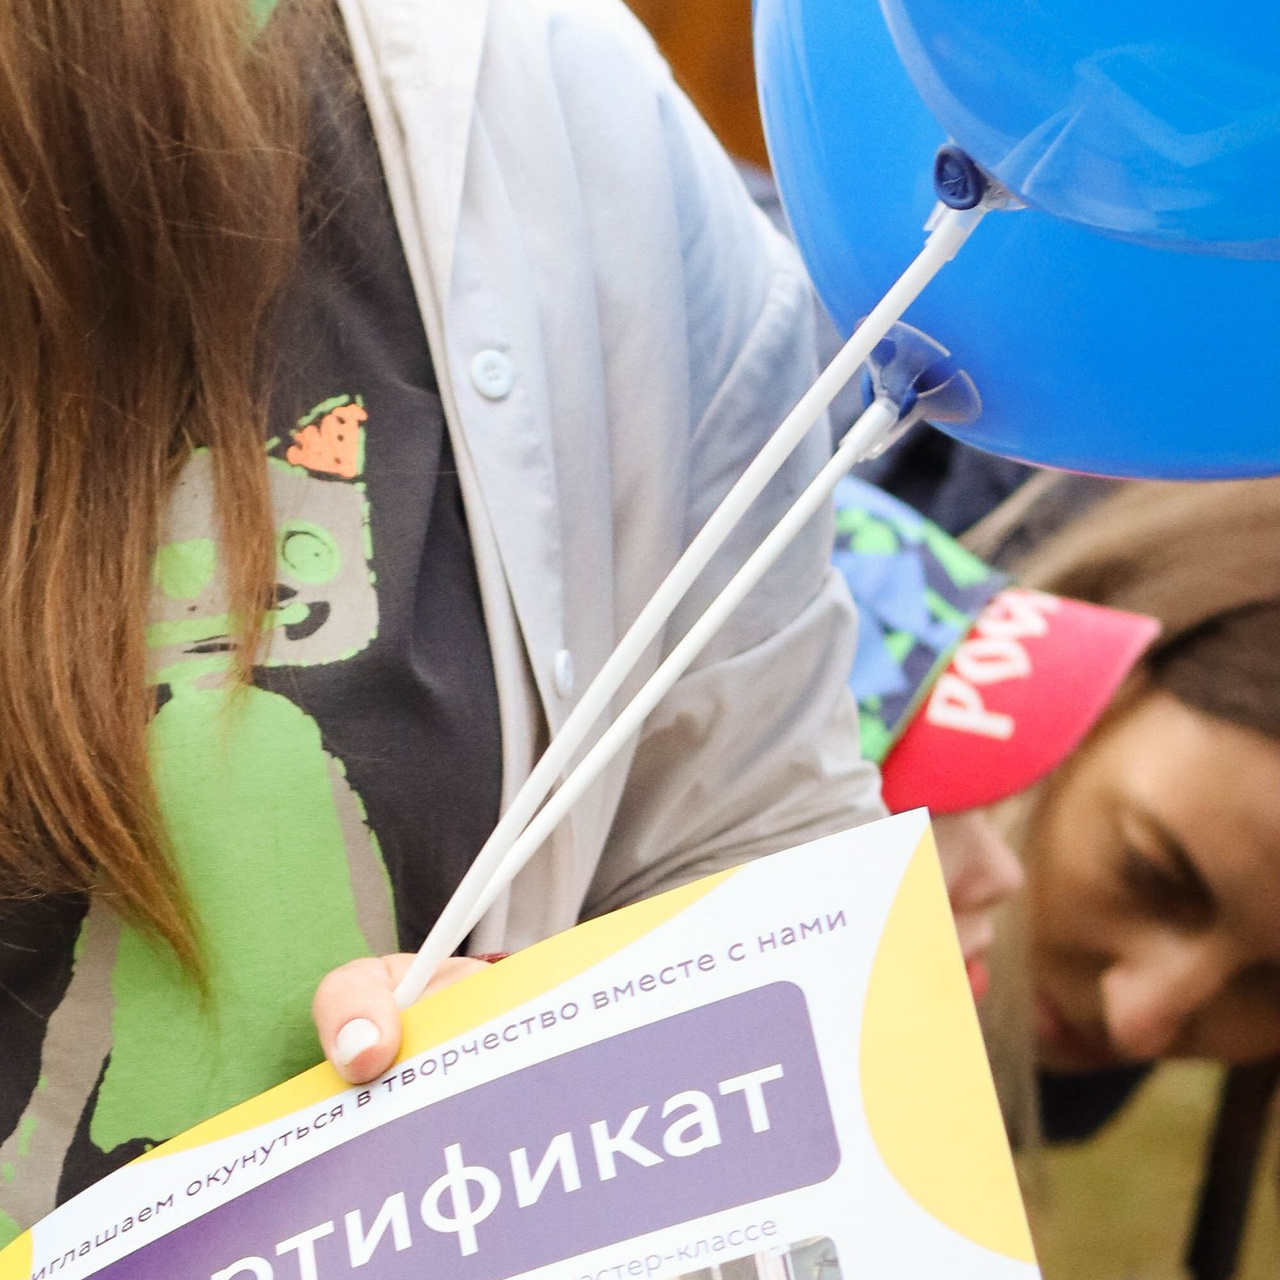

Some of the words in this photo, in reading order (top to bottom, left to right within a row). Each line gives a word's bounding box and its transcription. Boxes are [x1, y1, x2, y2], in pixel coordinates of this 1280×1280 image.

[186, 1103, 345, 1199] окунуться
[357, 1088, 373, 1110] в
[383, 1001, 578, 1094] творчество
[593, 952, 717, 1010] вместе
[728, 941, 746, 962] с
[757, 909, 848, 954] нами
